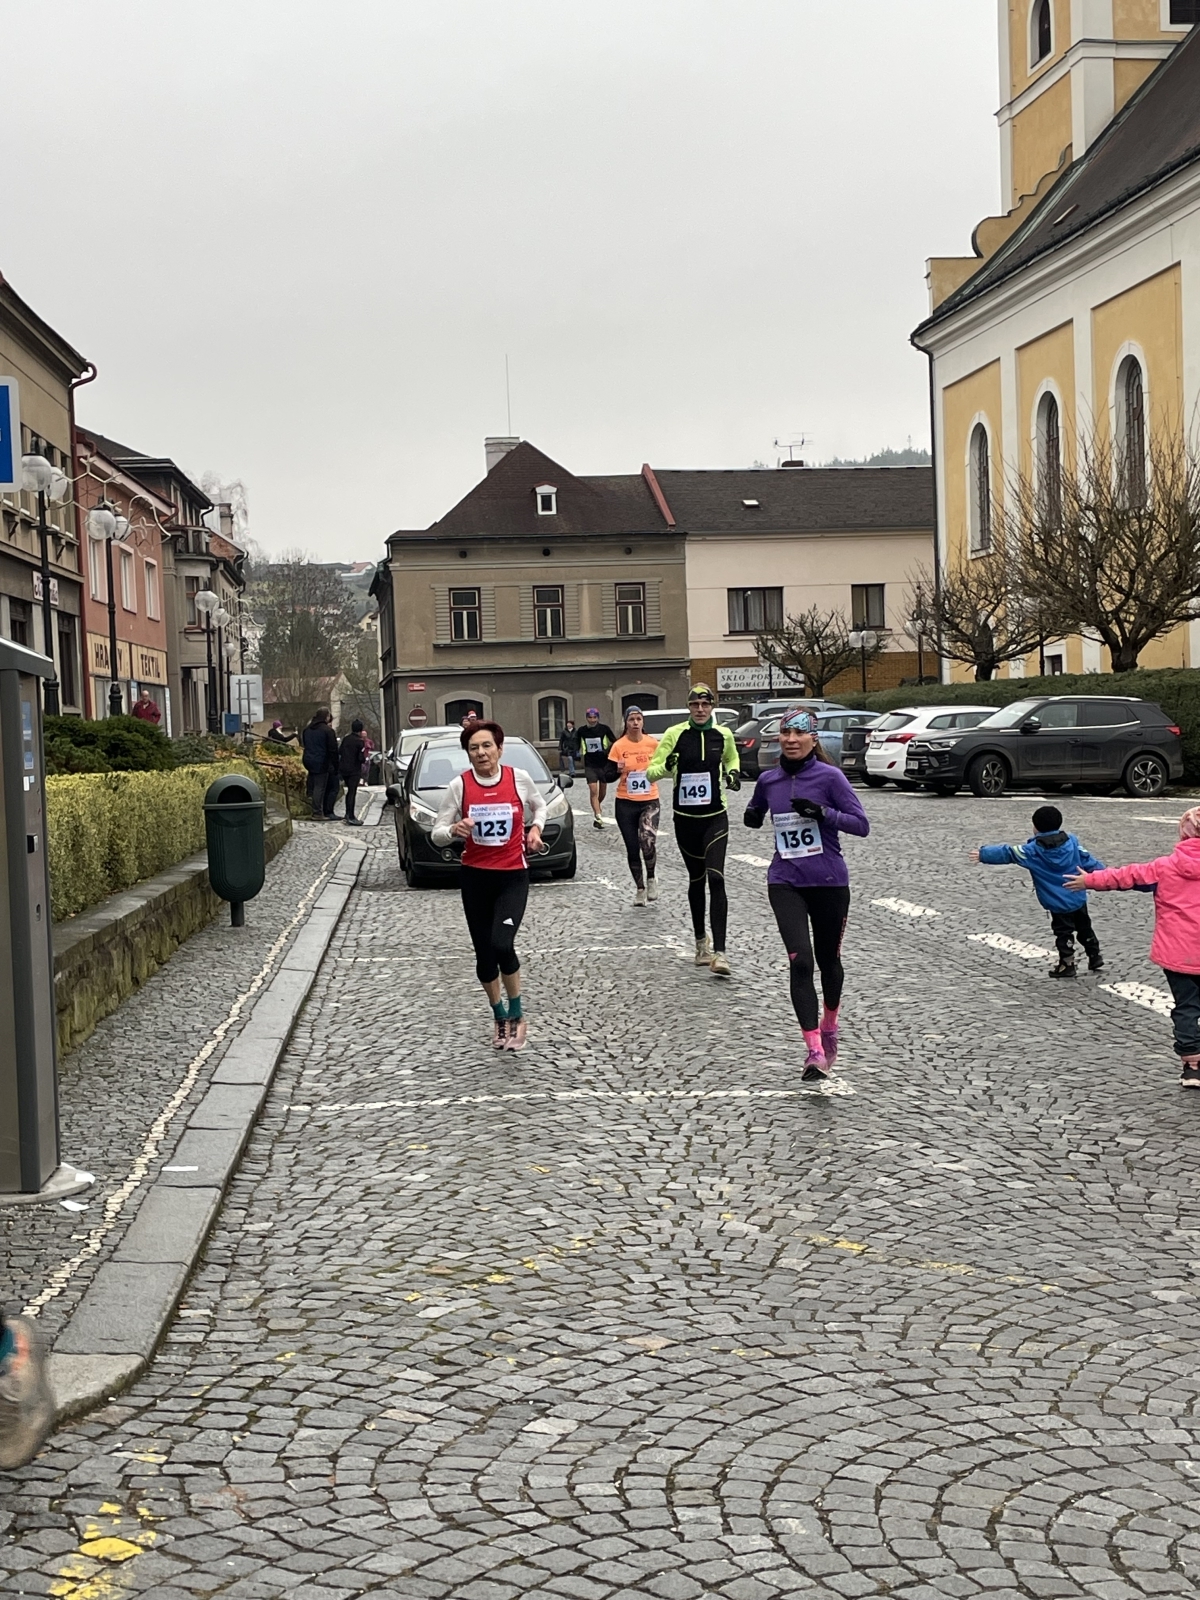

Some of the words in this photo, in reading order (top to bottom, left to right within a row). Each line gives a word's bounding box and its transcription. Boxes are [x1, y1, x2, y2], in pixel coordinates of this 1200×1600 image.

[94, 642, 122, 671] HRAY
[751, 672, 799, 681] PORCEL
[733, 680, 765, 688] DOMÁCÍ
[631, 780, 646, 790] 94
[681, 785, 707, 799] 149
[475, 820, 507, 837] 123
[780, 828, 814, 849] 136
